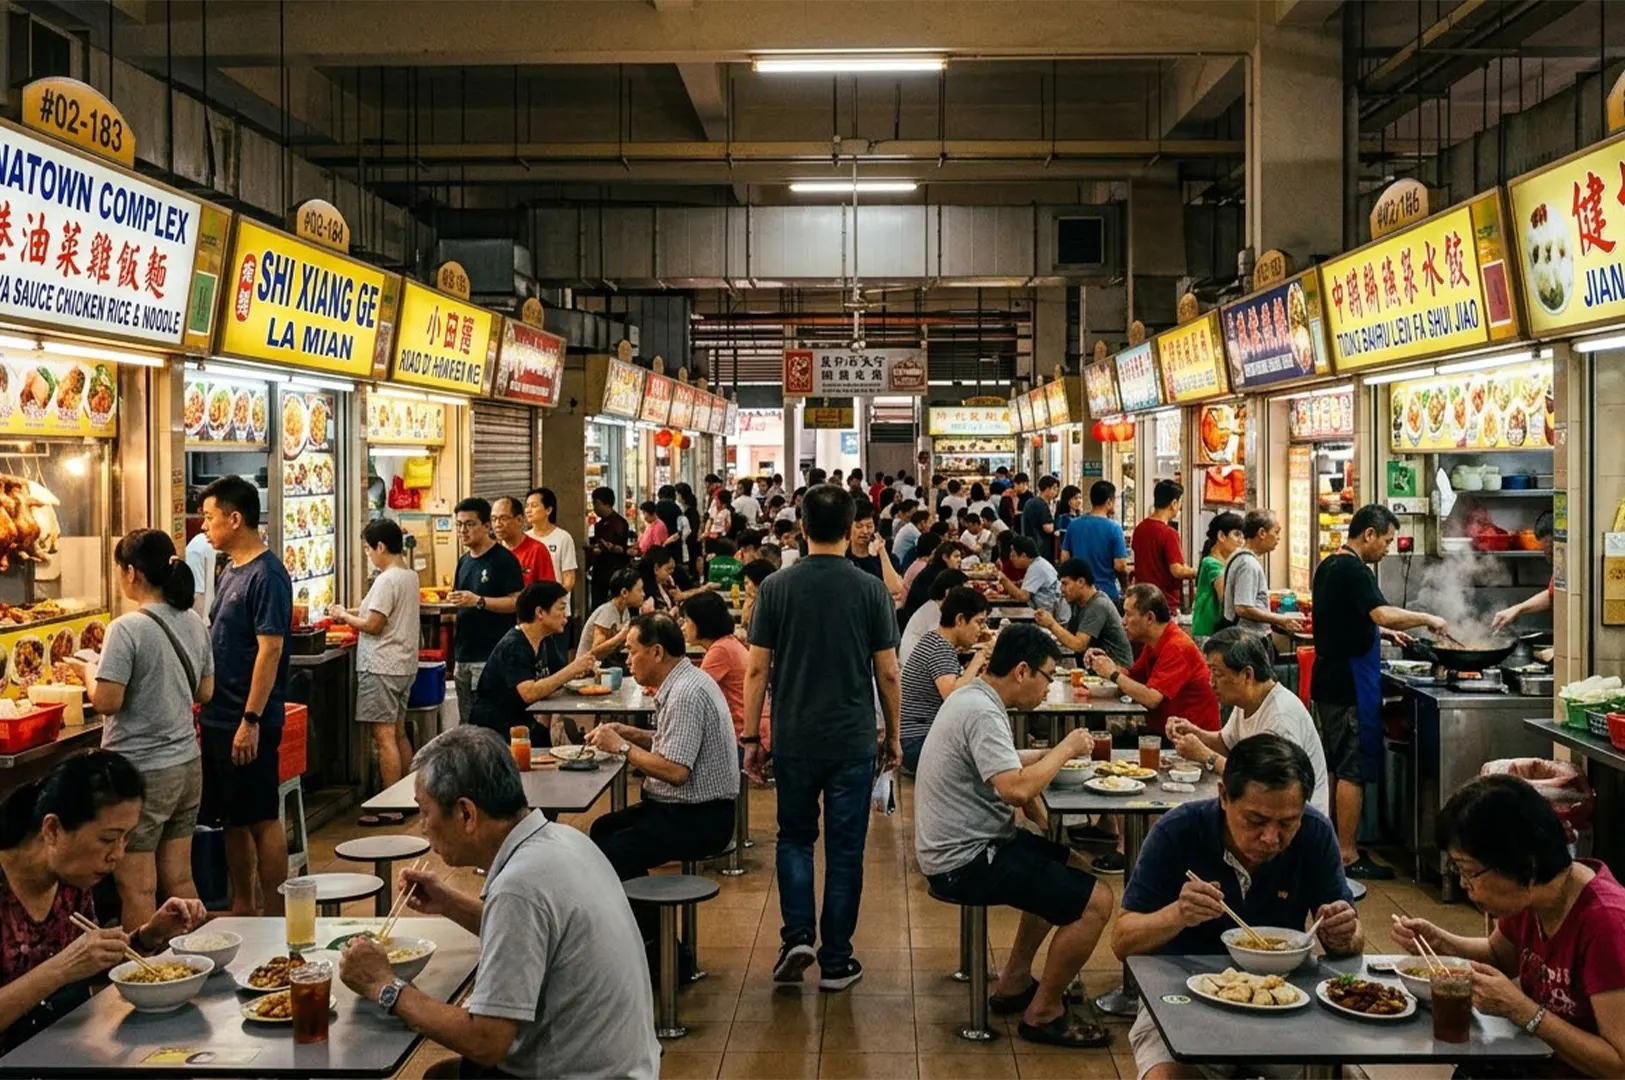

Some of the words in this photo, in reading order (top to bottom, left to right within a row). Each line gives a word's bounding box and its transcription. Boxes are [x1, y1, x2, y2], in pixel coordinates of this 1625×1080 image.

[40, 88, 122, 152] #02-183
[100, 182, 189, 244] COMPLEX
[13, 278, 54, 312] SAUCE
[107, 297, 132, 325] RICE
[142, 306, 181, 334] NOODLE
[258, 250, 296, 307] SHI
[296, 263, 353, 322] XIANG
[356, 282, 379, 328] GE
[1455, 299, 1479, 331] JIAO
[266, 317, 294, 350] LA
[302, 326, 353, 360] MIAN
